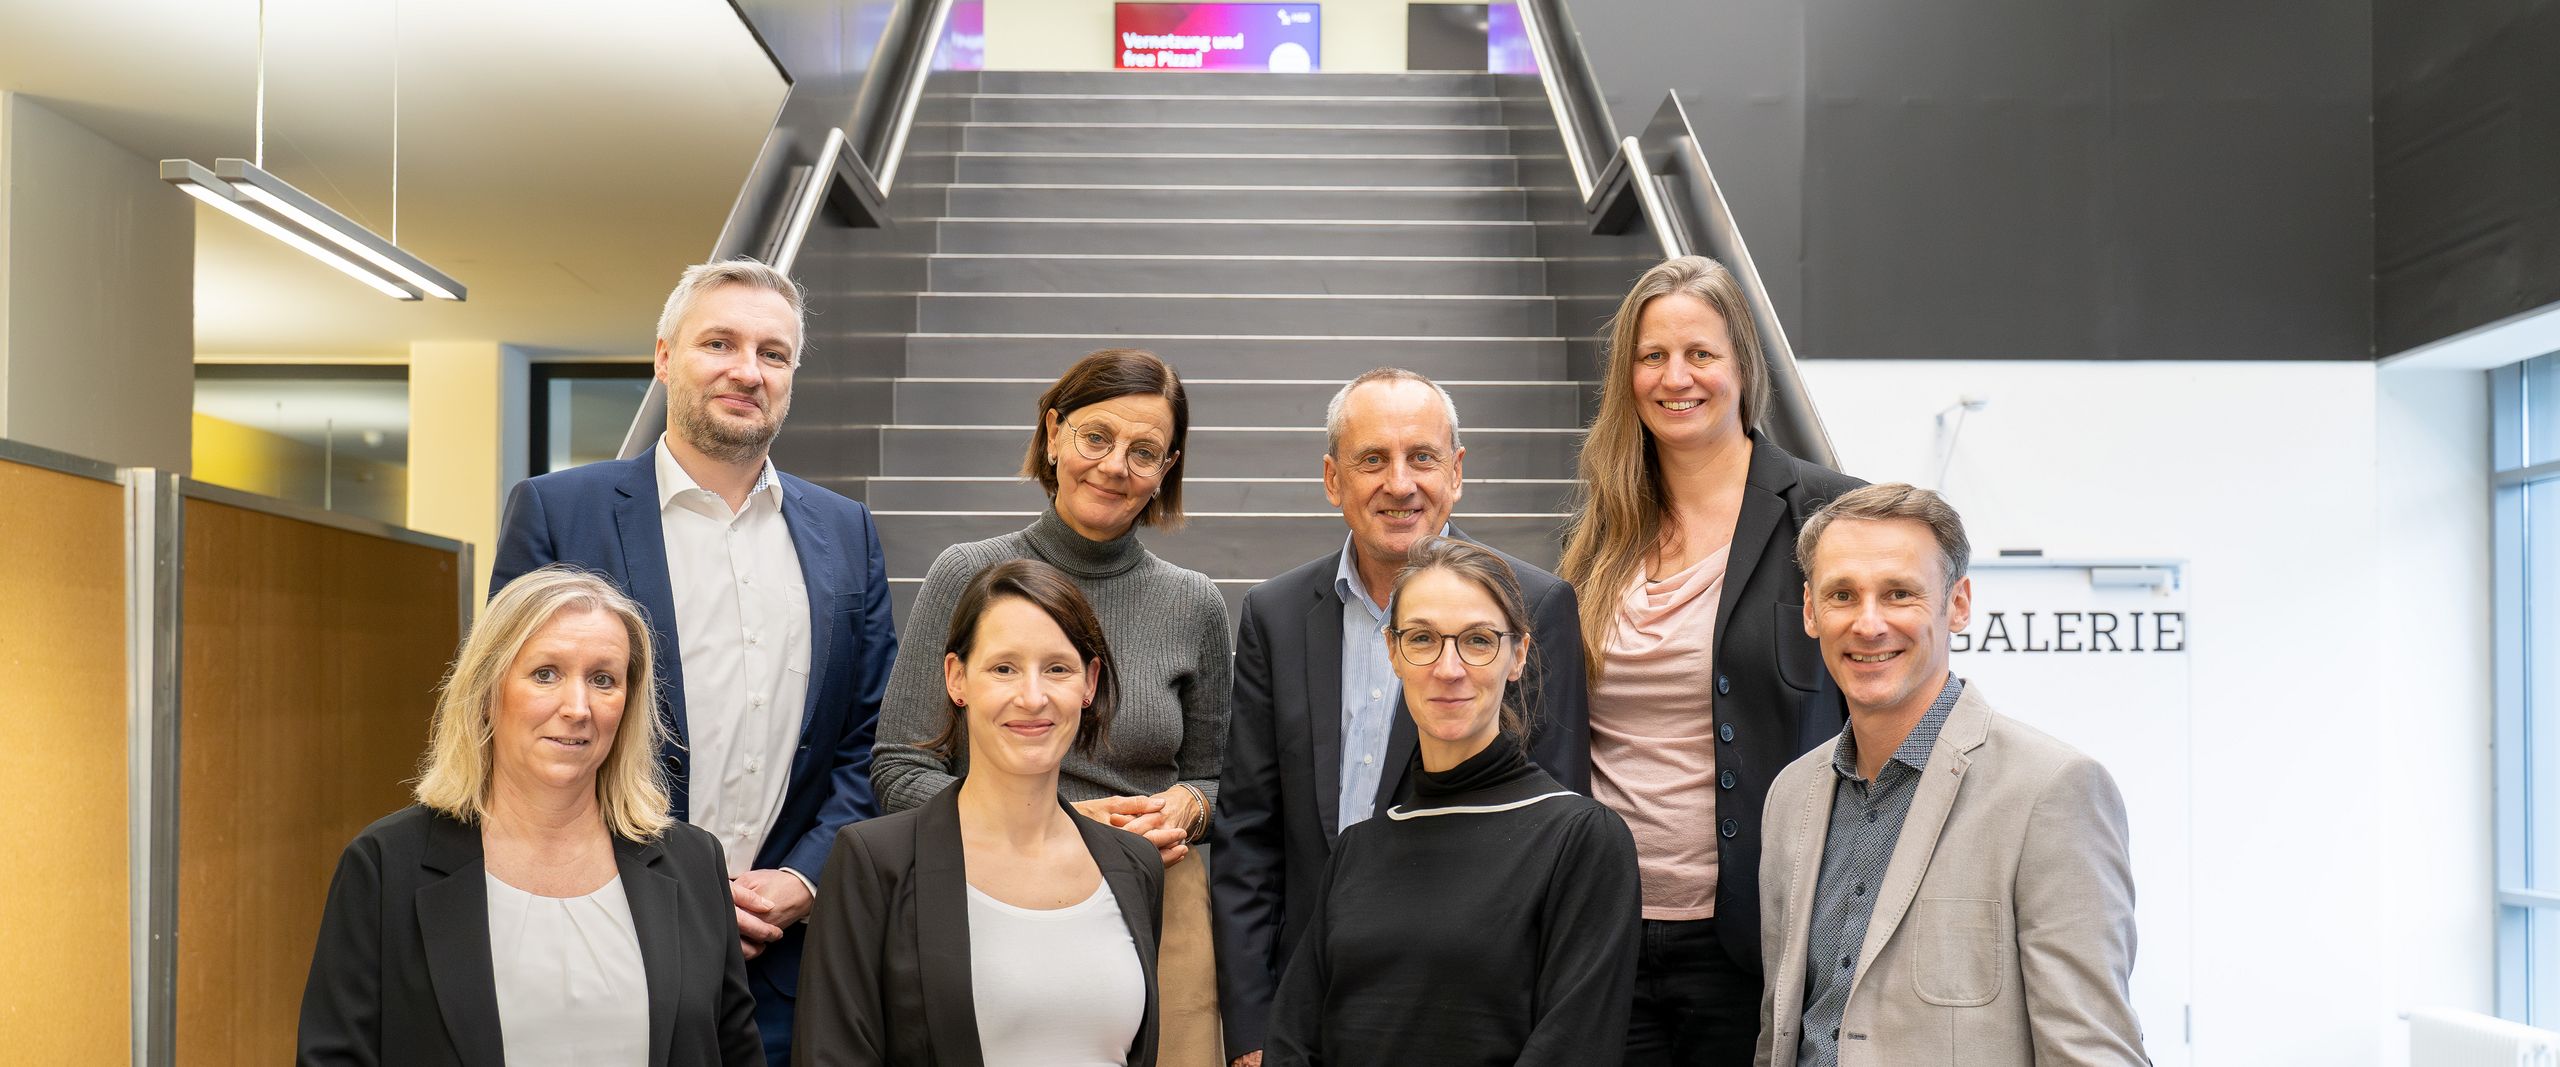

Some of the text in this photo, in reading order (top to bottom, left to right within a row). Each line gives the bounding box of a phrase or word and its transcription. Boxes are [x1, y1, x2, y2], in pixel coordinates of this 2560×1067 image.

[1122, 32, 1244, 52] Vernetzung und
[1122, 50, 1156, 67] free
